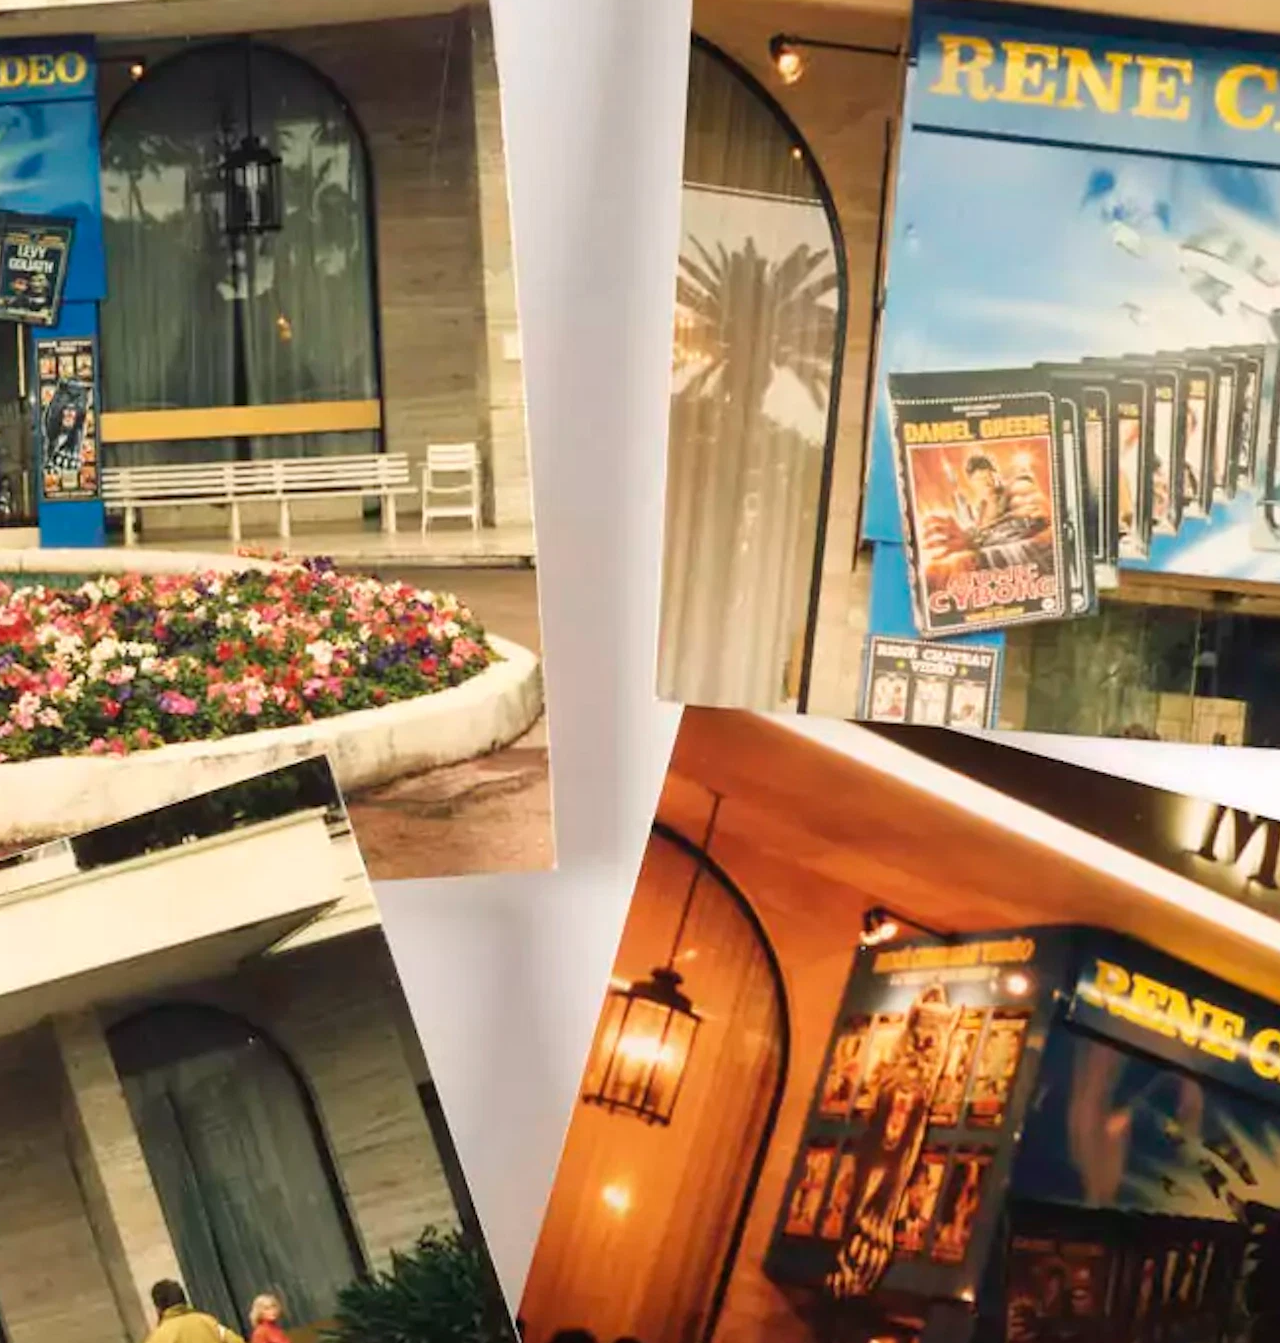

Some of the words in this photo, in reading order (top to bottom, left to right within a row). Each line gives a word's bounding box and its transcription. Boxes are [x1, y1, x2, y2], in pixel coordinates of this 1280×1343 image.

[929, 33, 1193, 121] RENE
[904, 420, 974, 443] DANIEL
[979, 414, 1051, 439] GREENE
[1082, 959, 1245, 1062] RENE
